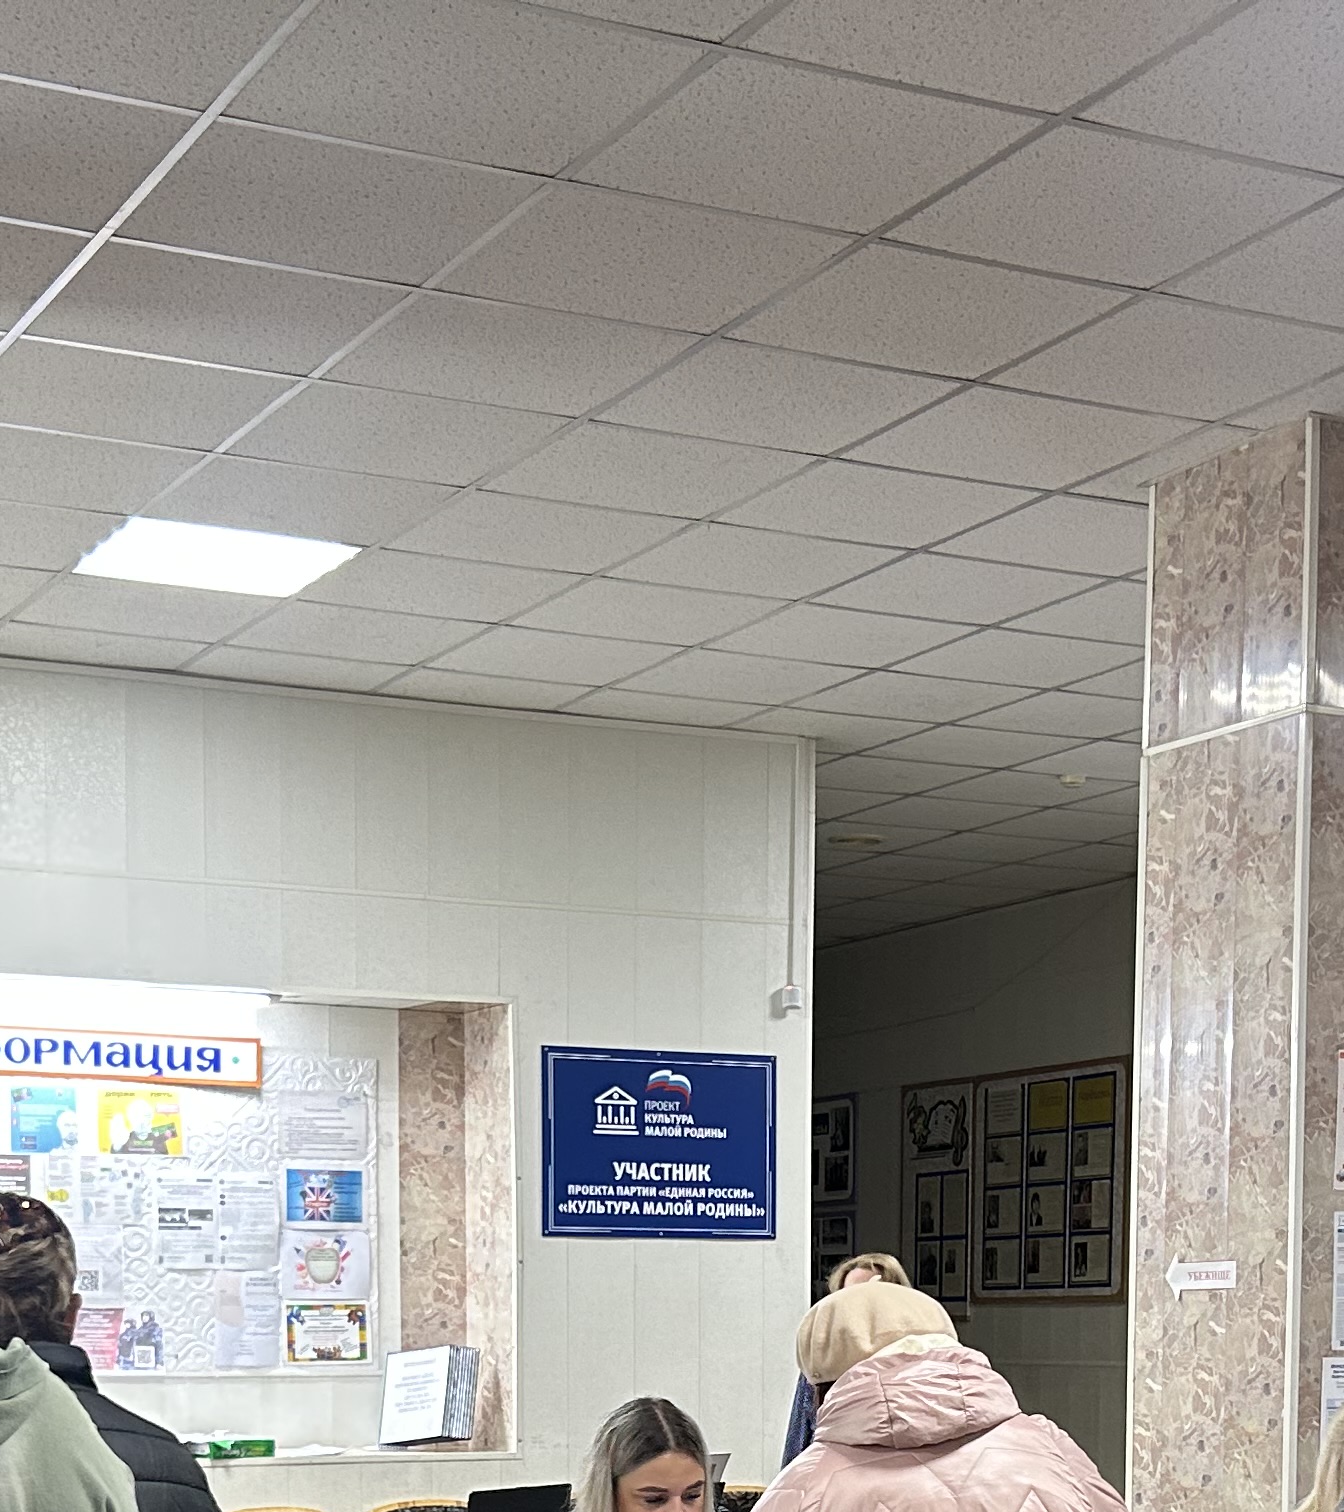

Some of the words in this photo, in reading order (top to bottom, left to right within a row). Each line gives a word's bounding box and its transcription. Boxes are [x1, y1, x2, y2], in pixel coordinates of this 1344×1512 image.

[644, 1100, 681, 1112] ПРОЕКТ
[644, 1113, 694, 1125] КУЛЬТУРА
[644, 1124, 682, 1137] МАЛОЙ
[683, 1127, 727, 1139] РОДИНЫ
[612, 1161, 711, 1182] УЧАСТНИК
[567, 1184, 615, 1196] ПРОЕКТА
[616, 1185, 656, 1196] ПАРТИИ
[658, 1187, 706, 1199] «ЕДИНАЯ
[708, 1188, 754, 1199] РОССИЯ»
[558, 1200, 640, 1215] «КУЛЬТУРА
[643, 1200, 694, 1215] МАЛОЙ
[697, 1202, 765, 1219] РОДИНЫ»
